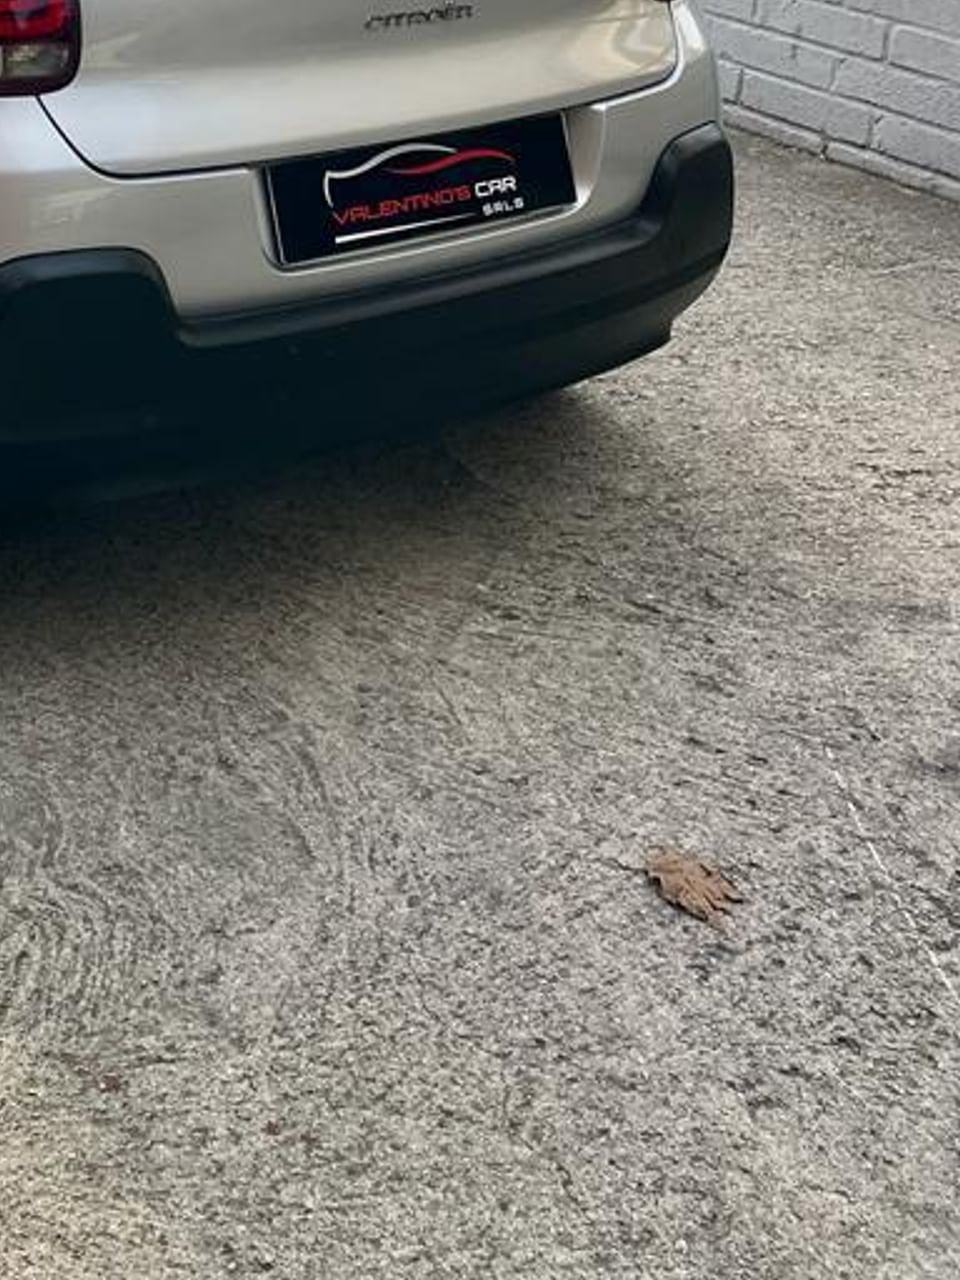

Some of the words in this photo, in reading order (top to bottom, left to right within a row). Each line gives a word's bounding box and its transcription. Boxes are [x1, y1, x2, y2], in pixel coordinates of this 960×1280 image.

[332, 185, 472, 225] VALENTINO'S
[474, 176, 517, 198] CAR
[481, 196, 525, 217] SRLS
